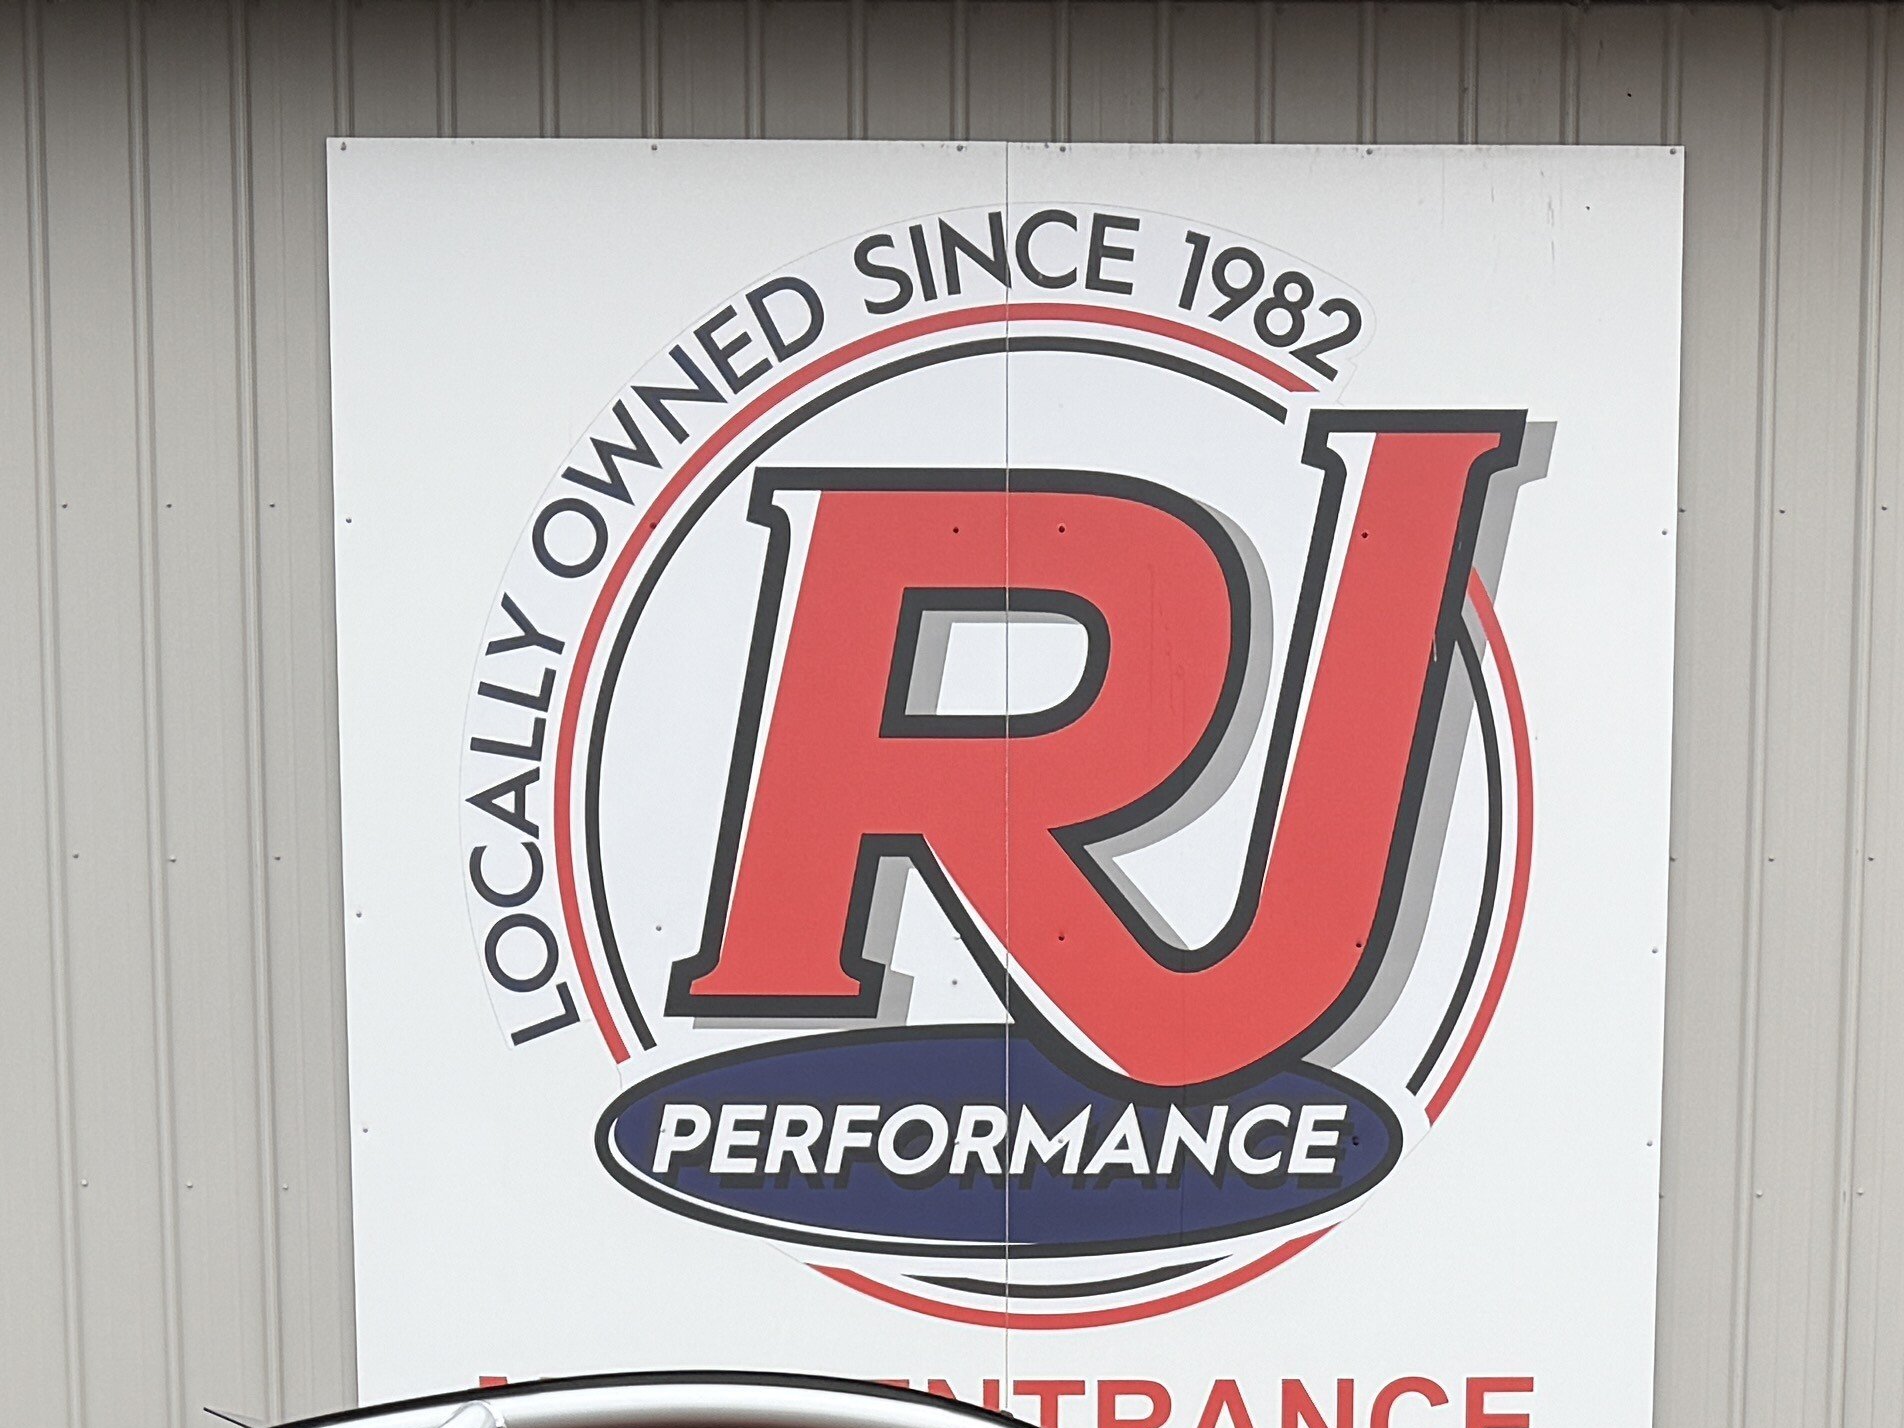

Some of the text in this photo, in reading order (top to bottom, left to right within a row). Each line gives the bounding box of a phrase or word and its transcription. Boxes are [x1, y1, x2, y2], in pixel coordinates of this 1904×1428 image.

[465, 210, 1362, 1046] LOCALLY OWNED SINCE 1982
[664, 408, 1528, 1106] RJ
[652, 1103, 1348, 1176] PERFORMANCE
